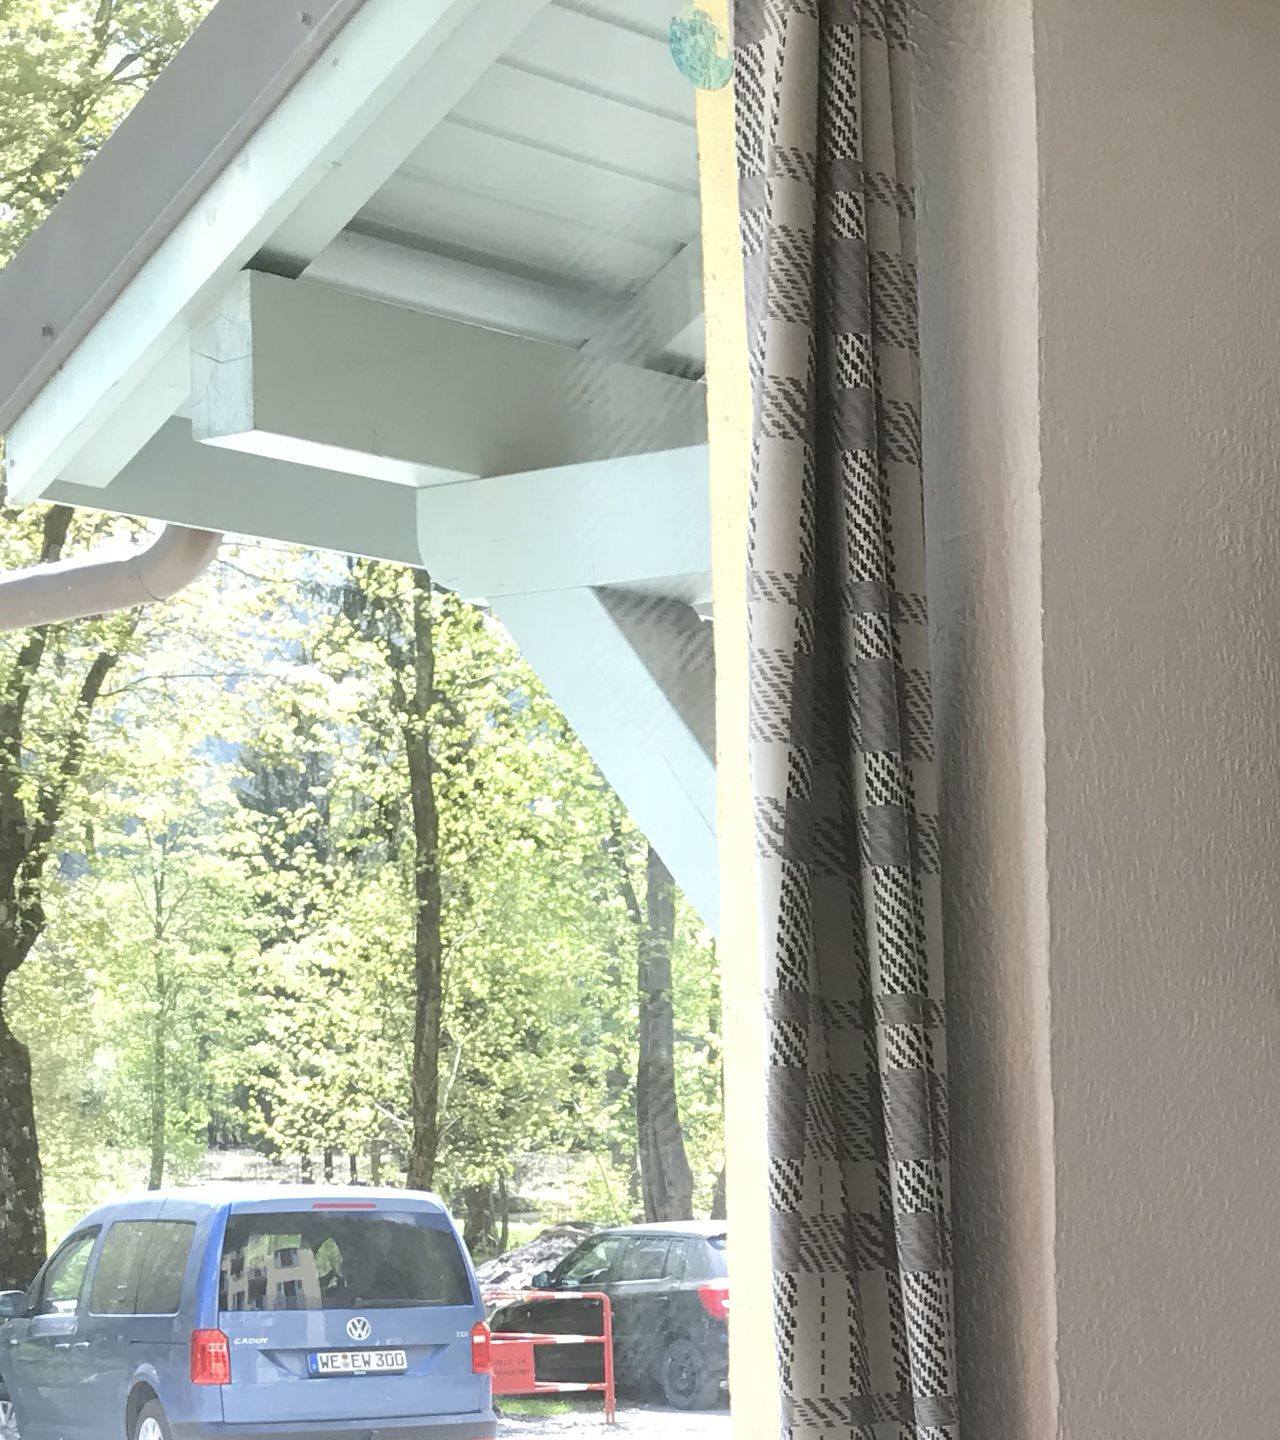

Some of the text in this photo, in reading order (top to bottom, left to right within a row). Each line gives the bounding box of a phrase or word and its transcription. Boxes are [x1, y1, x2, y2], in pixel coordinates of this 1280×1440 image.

[233, 1337, 269, 1345] CADDY
[320, 1355, 340, 1368] WE
[351, 1354, 371, 1368] EW
[376, 1353, 404, 1367] 300
